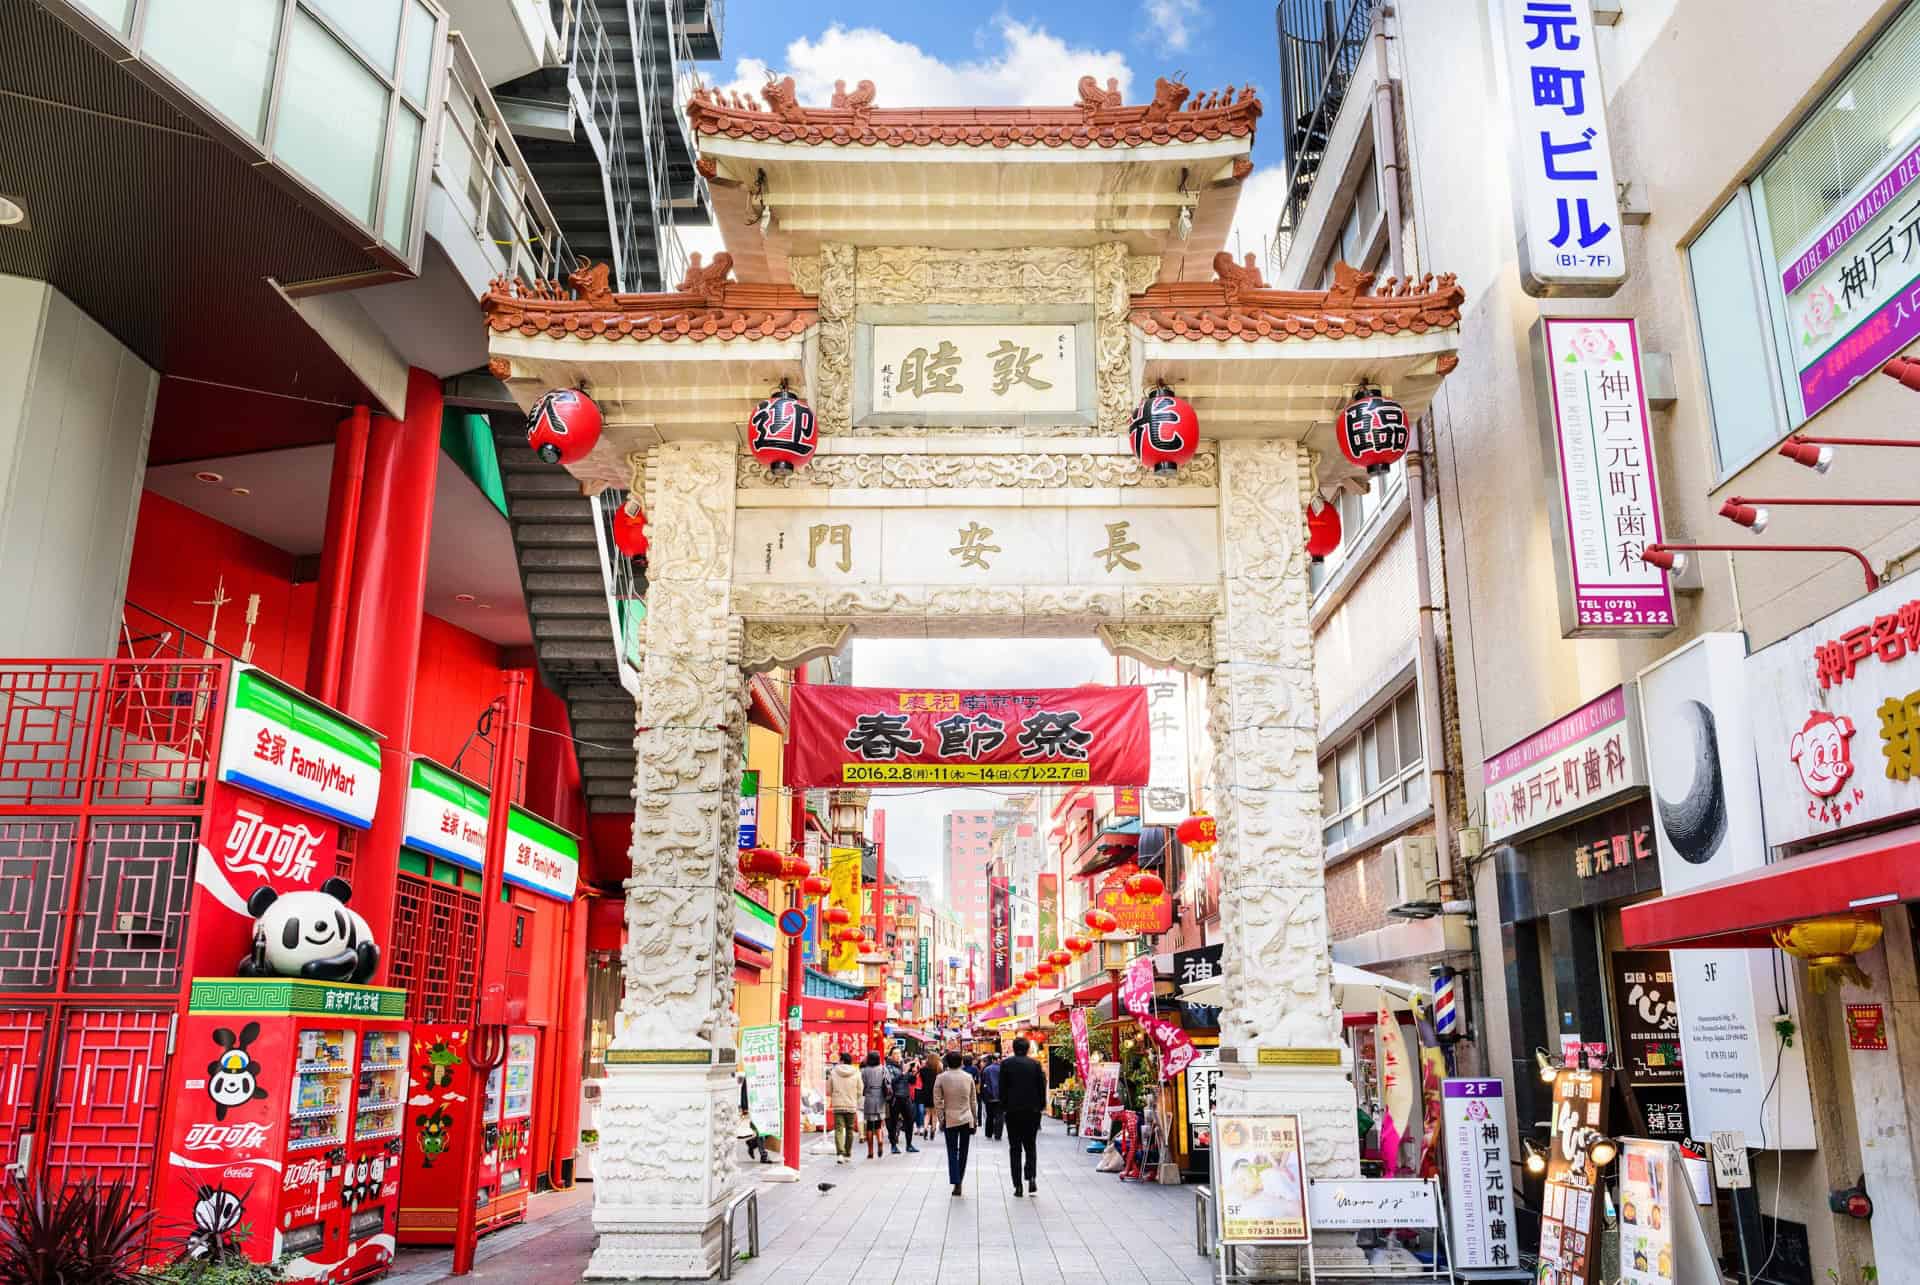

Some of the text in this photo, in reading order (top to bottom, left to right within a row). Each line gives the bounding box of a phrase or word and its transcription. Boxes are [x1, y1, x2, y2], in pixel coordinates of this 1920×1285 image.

[1523, 2, 1611, 249] 元町ビル
[1795, 244, 1823, 282] KOBE
[1827, 177, 1896, 256] MOTOMACHI
[752, 399, 815, 456] 迎
[1597, 369, 1649, 574] 神戸元町歯科
[1579, 599, 1637, 609] TEL (078)
[1580, 611, 1669, 623] 335-2122
[254, 728, 287, 766] 全家
[844, 711, 1093, 760] 春節祭
[289, 747, 355, 796] FamilyMart
[1490, 760, 1501, 780] 2F
[1510, 734, 1625, 825] 神戸元町歯科
[440, 808, 460, 836] 全家
[1808, 787, 1864, 824] とんちゃん
[1704, 962, 1718, 982] 3F
[324, 991, 380, 1012] 南京町北京城
[1465, 1084, 1488, 1095] 2F
[1682, 1137, 1705, 1155] B1F
[1227, 1205, 1241, 1215] 5F
[1481, 1123, 1510, 1265] 神戸元町歯科
